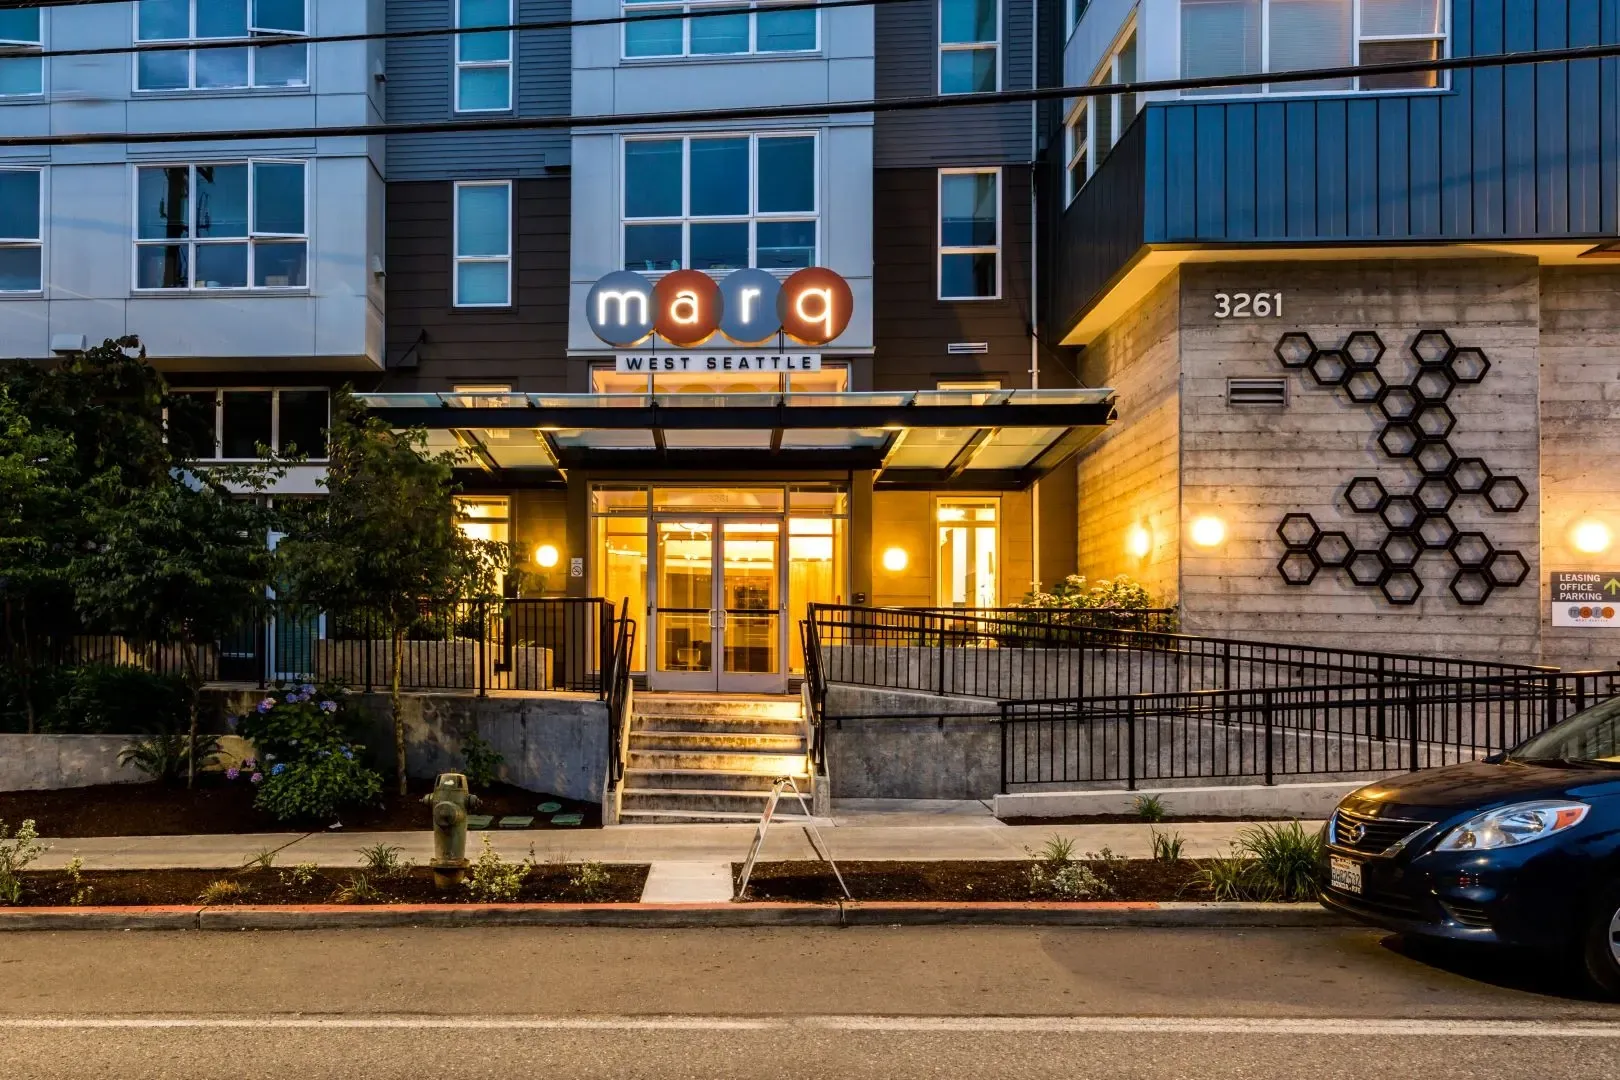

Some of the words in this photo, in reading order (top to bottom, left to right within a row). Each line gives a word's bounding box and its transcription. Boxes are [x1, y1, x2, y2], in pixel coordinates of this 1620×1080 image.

[1214, 292, 1282, 318] 3261
[598, 287, 832, 338] marq
[626, 357, 691, 370] WEST
[706, 356, 812, 370] SEATTLE
[1559, 574, 1601, 582] LEASING
[1559, 583, 1593, 591] OFFICE
[1559, 592, 1603, 601] PARKING
